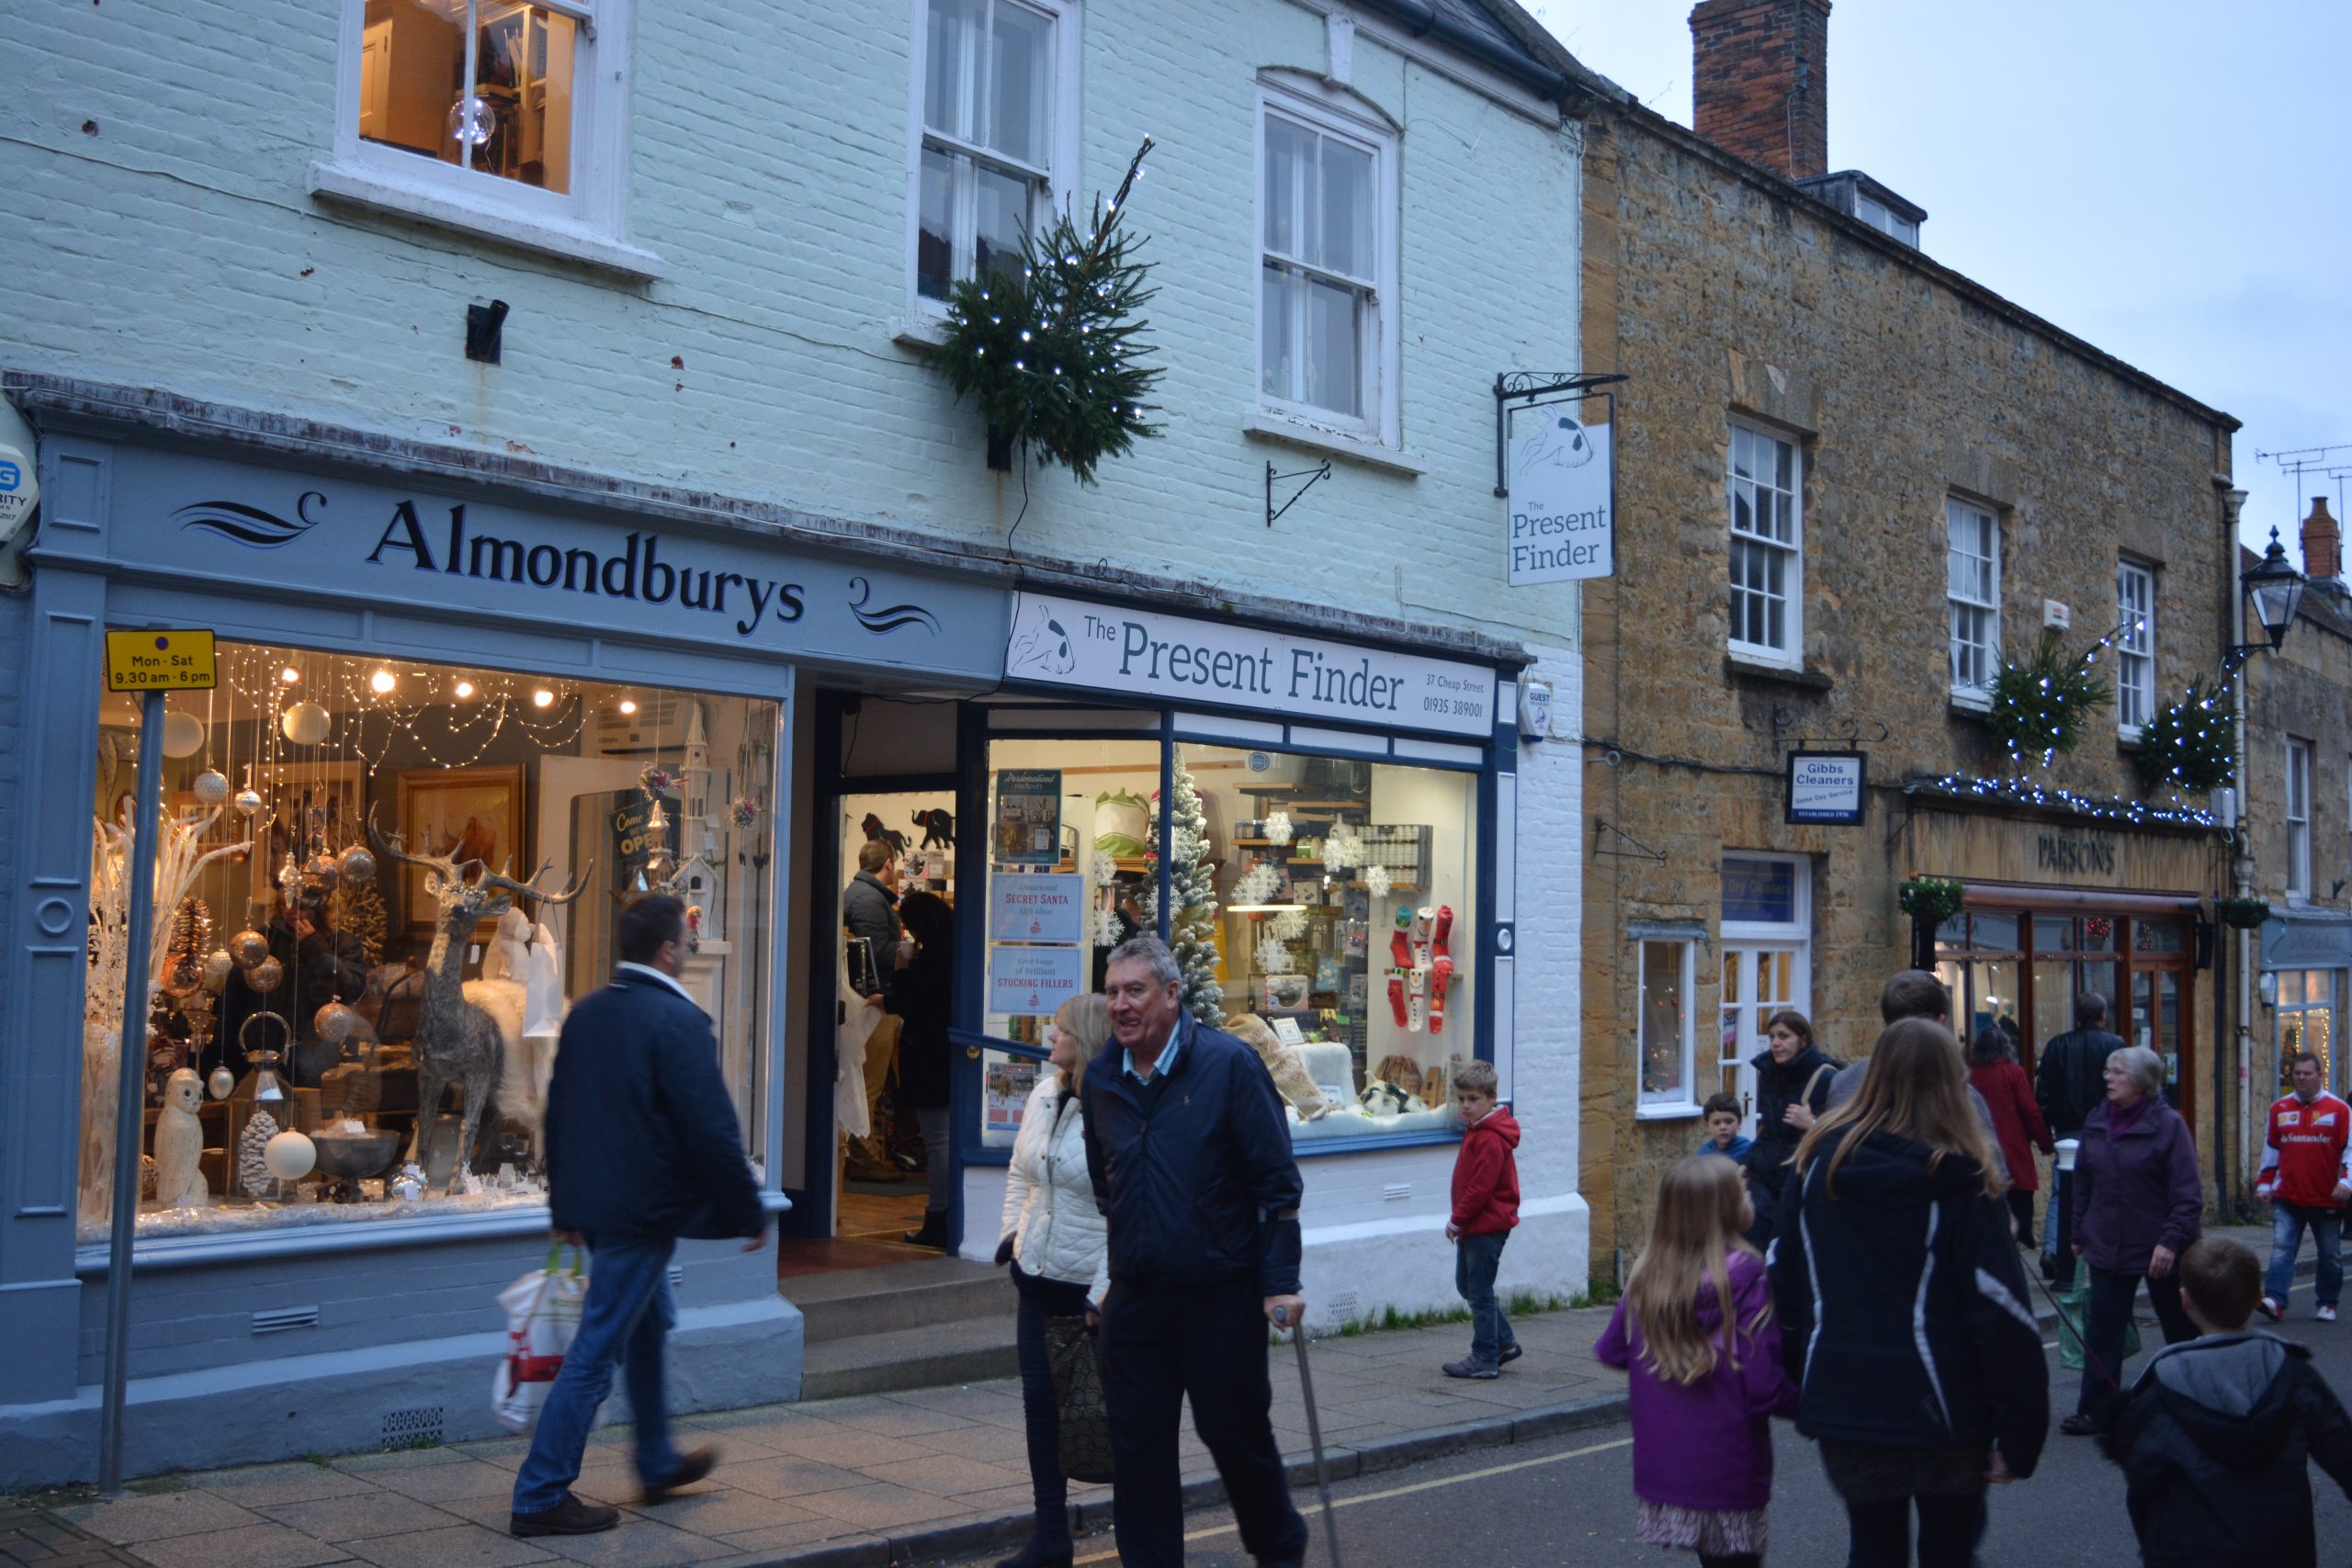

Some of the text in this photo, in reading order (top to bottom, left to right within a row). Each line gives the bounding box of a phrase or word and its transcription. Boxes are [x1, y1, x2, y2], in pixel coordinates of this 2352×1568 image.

[1528, 502, 1544, 512] The
[1512, 504, 1607, 539] Present
[1512, 539, 1600, 572] Finder
[365, 499, 806, 637] Almondburys
[132, 655, 161, 667] Mon
[171, 654, 194, 666] Sat
[1083, 615, 1406, 712] The Present Finder
[115, 671, 147, 683] 9.30
[150, 673, 170, 682] am
[179, 671, 188, 682] 6
[191, 671, 210, 683] pm
[1426, 673, 1484, 694] 37 Cheap Street
[1529, 692, 1551, 703] GUEST
[1423, 696, 1483, 717] 01935 389001
[1807, 763, 1844, 773] Gibbs
[1796, 774, 1854, 785] Cleaners
[1828, 789, 1853, 798] Service
[621, 832, 654, 855] OPE
[2038, 834, 2116, 876] PARSONS
[1005, 893, 1069, 905] SECRET SANTA
[1015, 966, 1056, 976] of Brilliant
[998, 977, 1074, 989] STOCKING FILLERS
[2287, 1133, 2331, 1144] Santander
